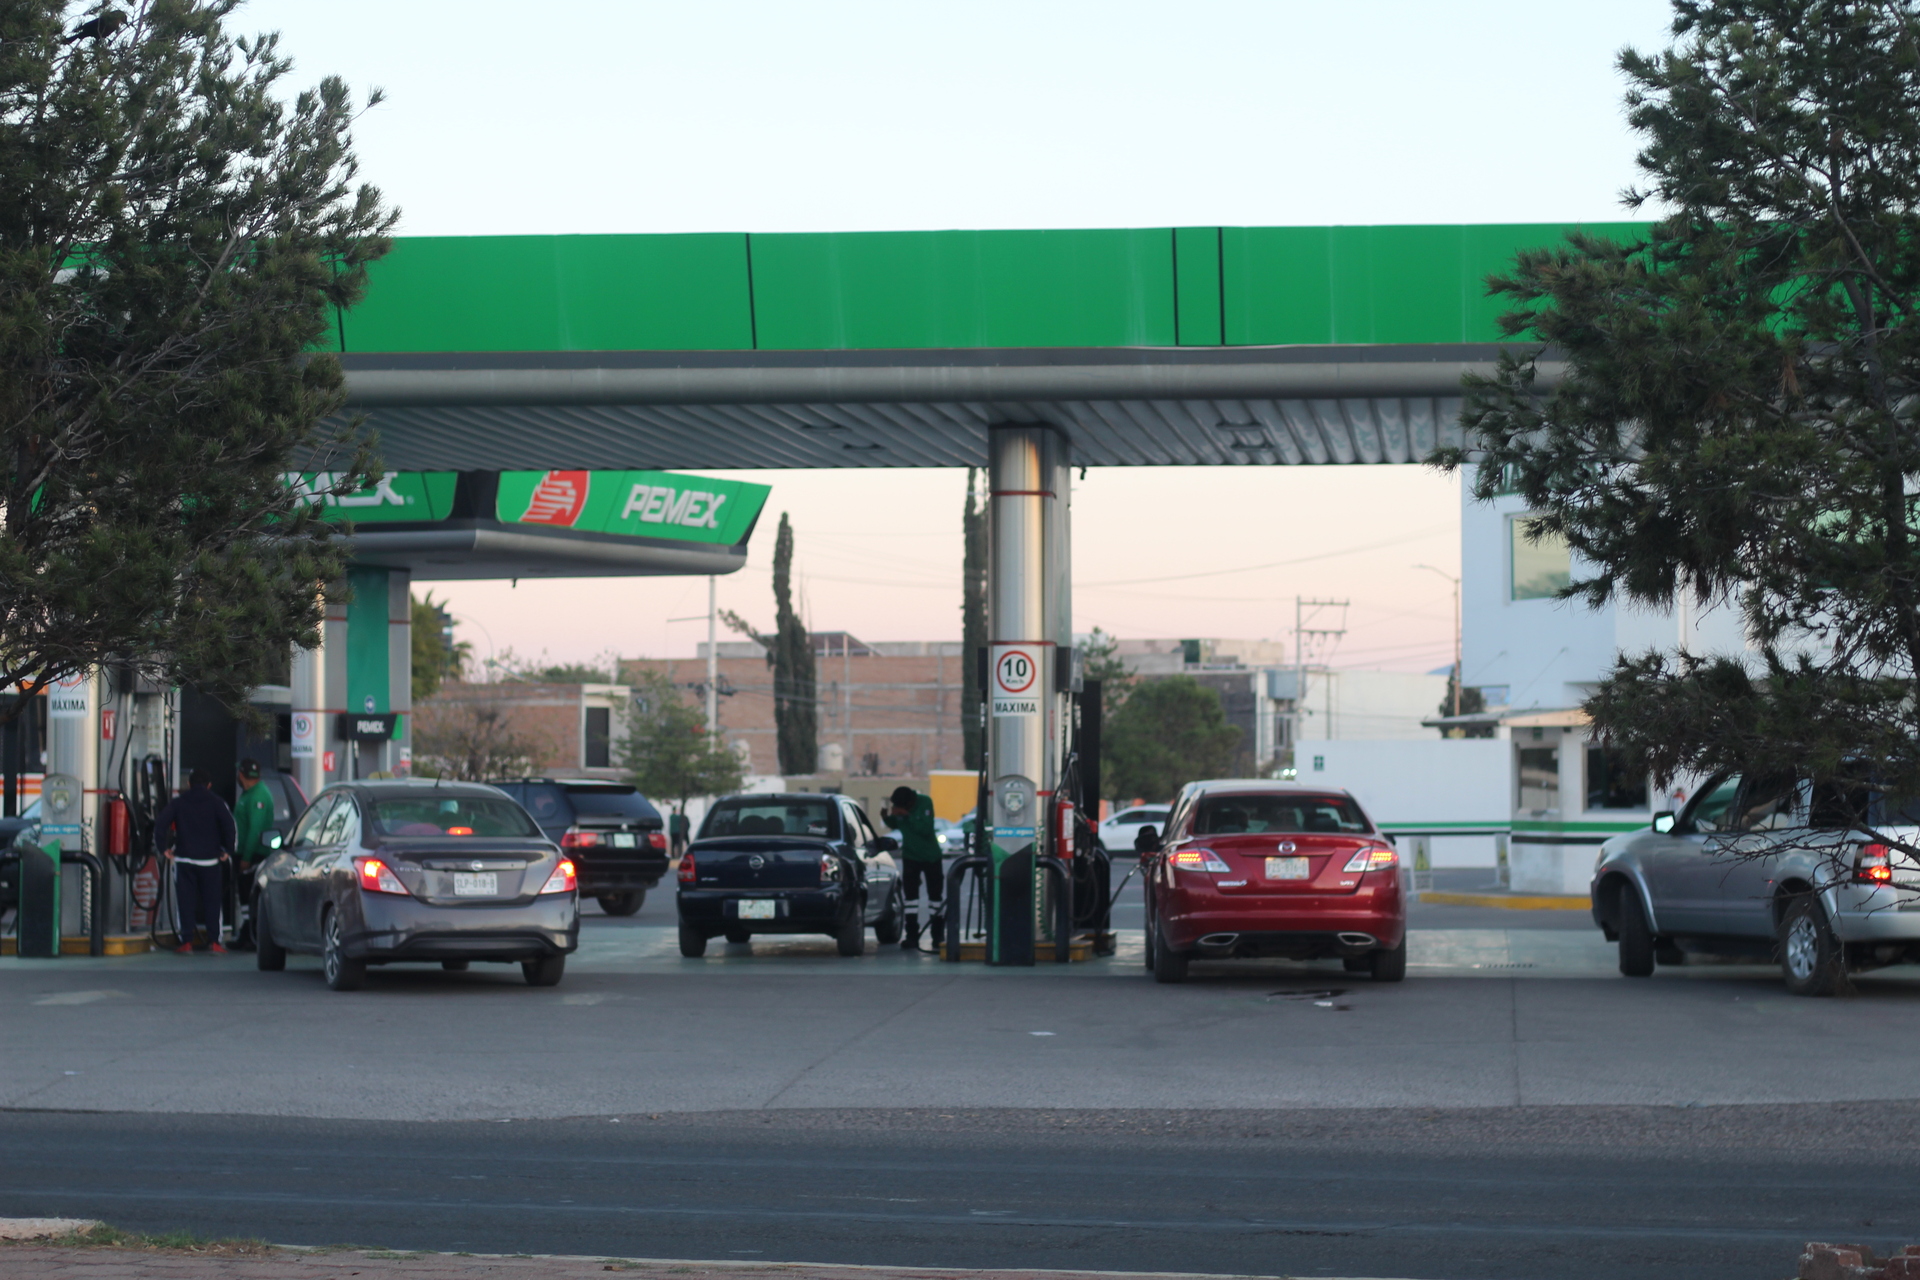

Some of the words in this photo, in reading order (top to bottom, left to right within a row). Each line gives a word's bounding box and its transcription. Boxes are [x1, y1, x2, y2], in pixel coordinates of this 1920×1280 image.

[275, 471, 405, 508] MEX
[620, 483, 727, 529] PEMEX
[1003, 658, 1027, 677] 10
[295, 719, 308, 732] 10
